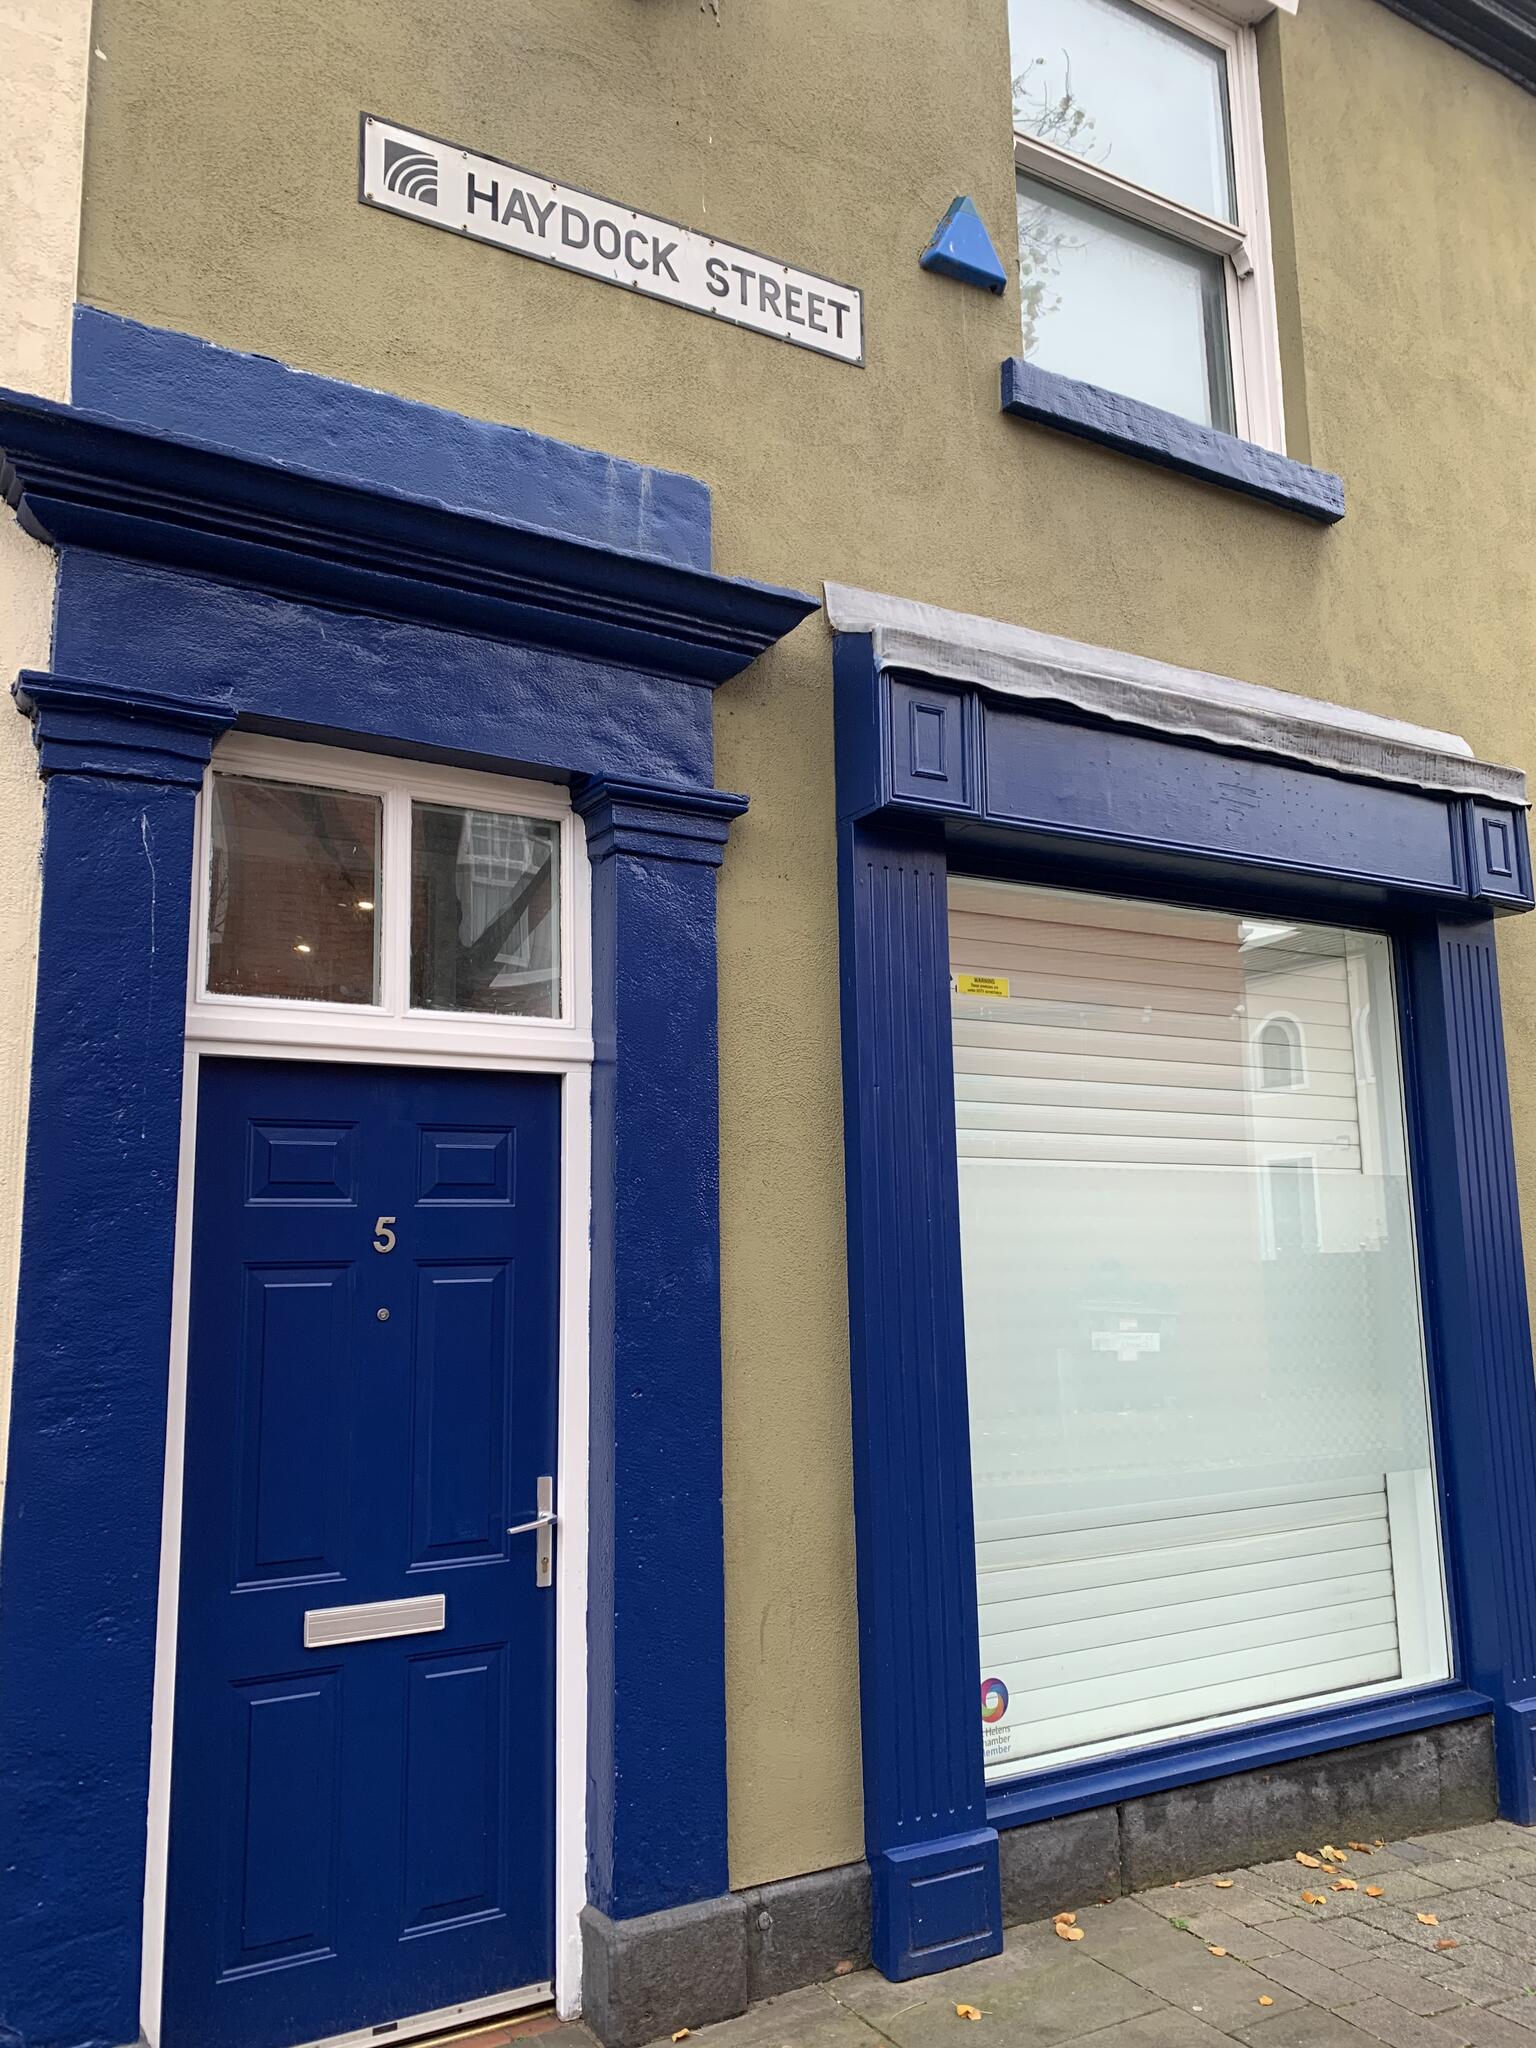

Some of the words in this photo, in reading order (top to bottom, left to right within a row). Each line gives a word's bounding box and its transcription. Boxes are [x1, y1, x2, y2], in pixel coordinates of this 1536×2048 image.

[467, 172, 680, 283] HAYDOCK
[705, 257, 851, 340] STREET
[373, 1216, 396, 1253] 5
[986, 1725, 1011, 1737] Helens
[985, 1746, 1011, 1757] ember
